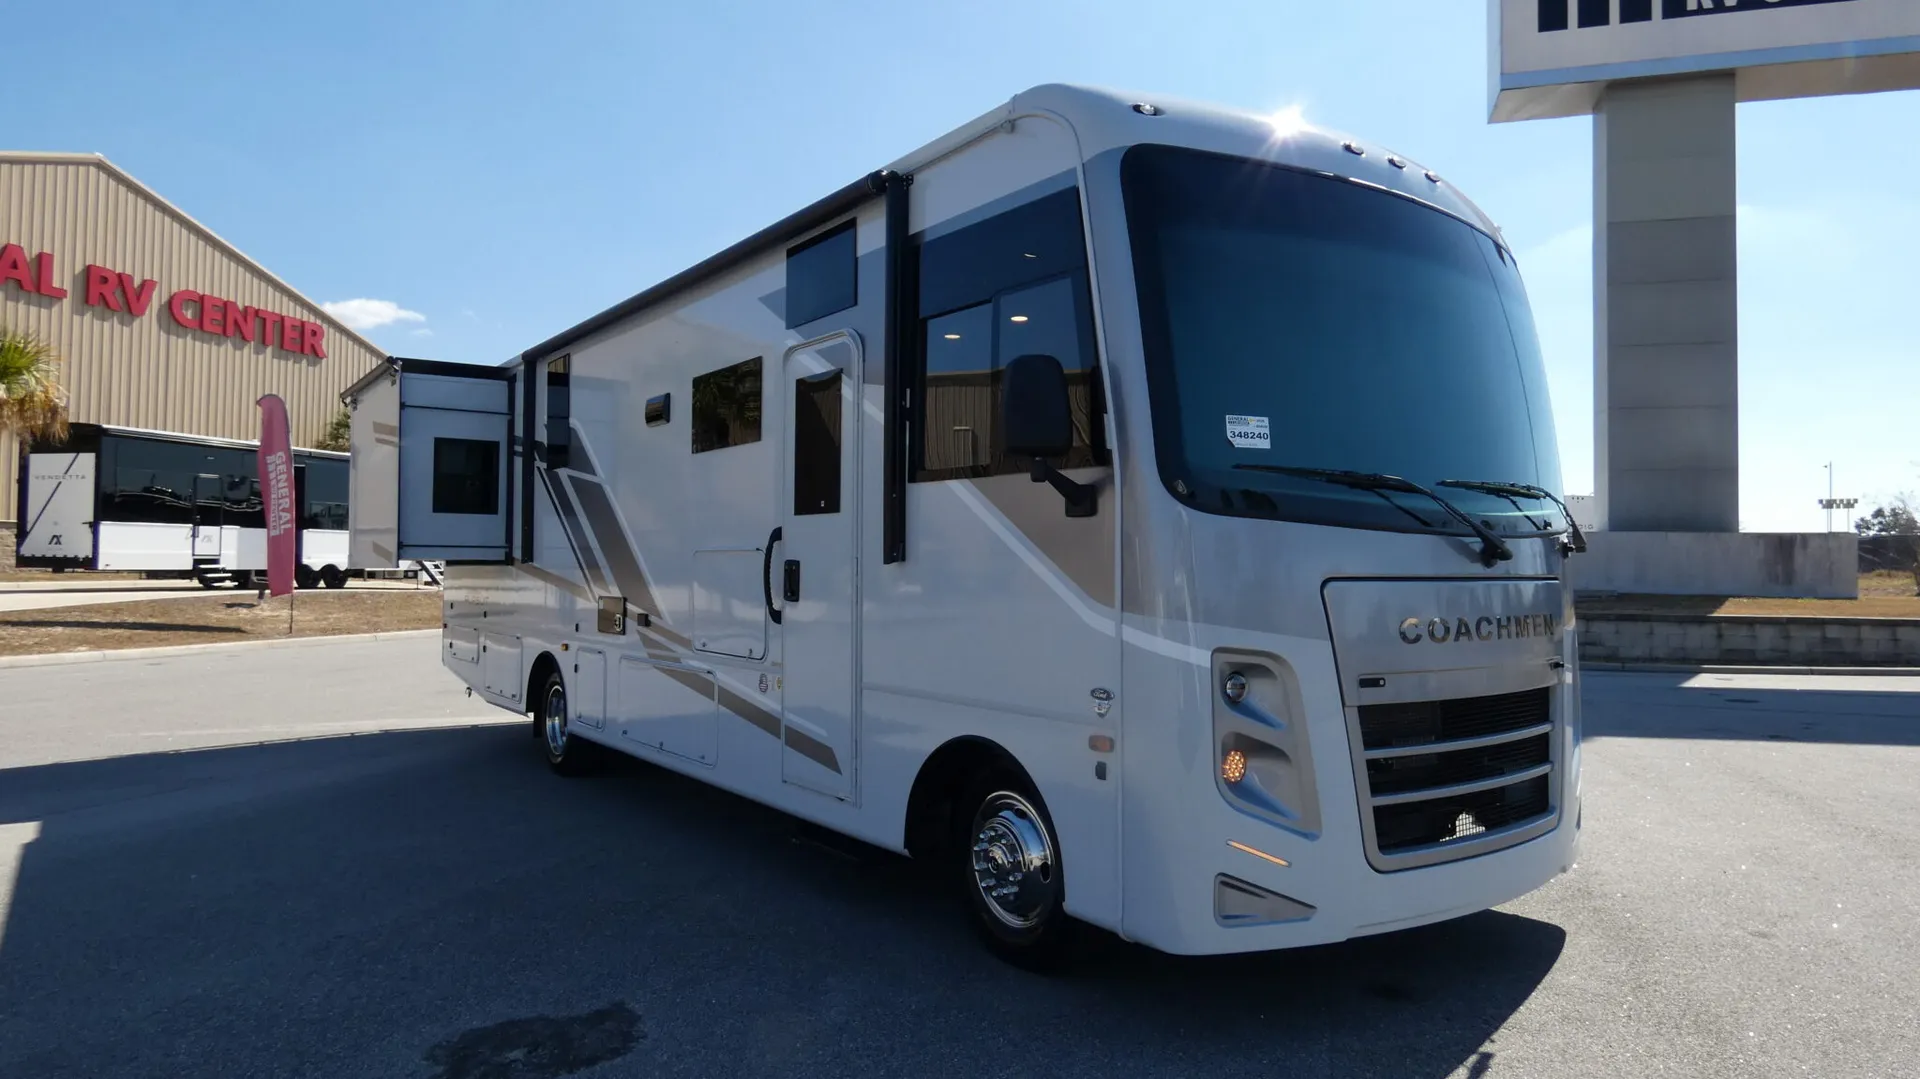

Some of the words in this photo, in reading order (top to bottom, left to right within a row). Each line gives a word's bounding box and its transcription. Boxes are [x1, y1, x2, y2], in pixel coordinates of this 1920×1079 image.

[86, 264, 157, 317] RV
[169, 289, 327, 359] CENTER
[1229, 430, 1269, 440] 348240
[276, 451, 292, 534] GENERAL
[1398, 613, 1555, 645] COACHMEN
